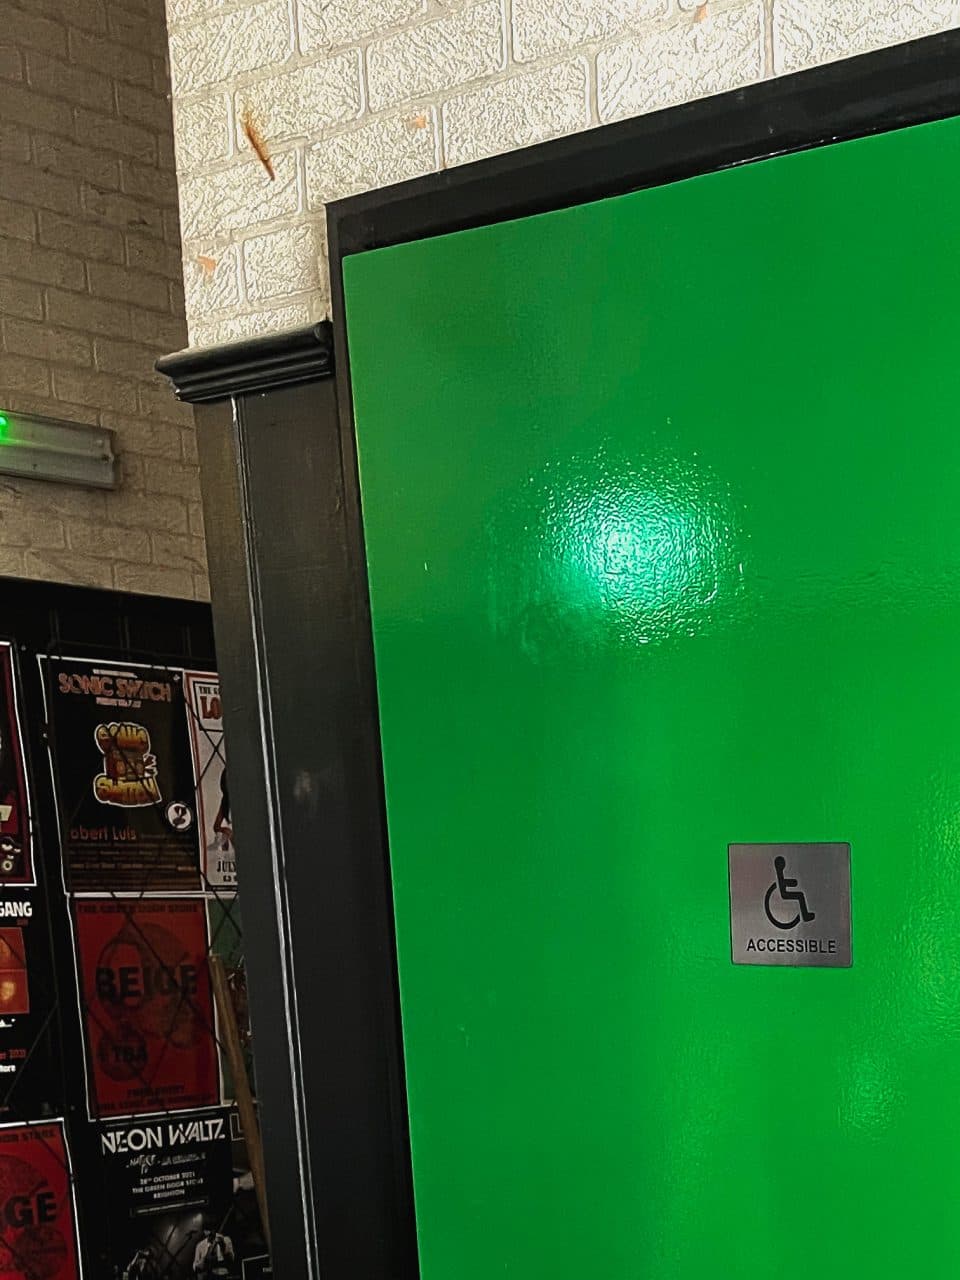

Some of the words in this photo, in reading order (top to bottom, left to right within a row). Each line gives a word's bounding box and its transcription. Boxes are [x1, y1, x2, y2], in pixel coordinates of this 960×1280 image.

[58, 672, 114, 697] SONIC
[115, 678, 171, 703] SWITCH
[746, 938, 837, 954] ACCESSIBLE
[101, 1125, 163, 1156] NEON
[168, 1118, 226, 1147] WALTZ
[5, 1191, 57, 1228] GE
